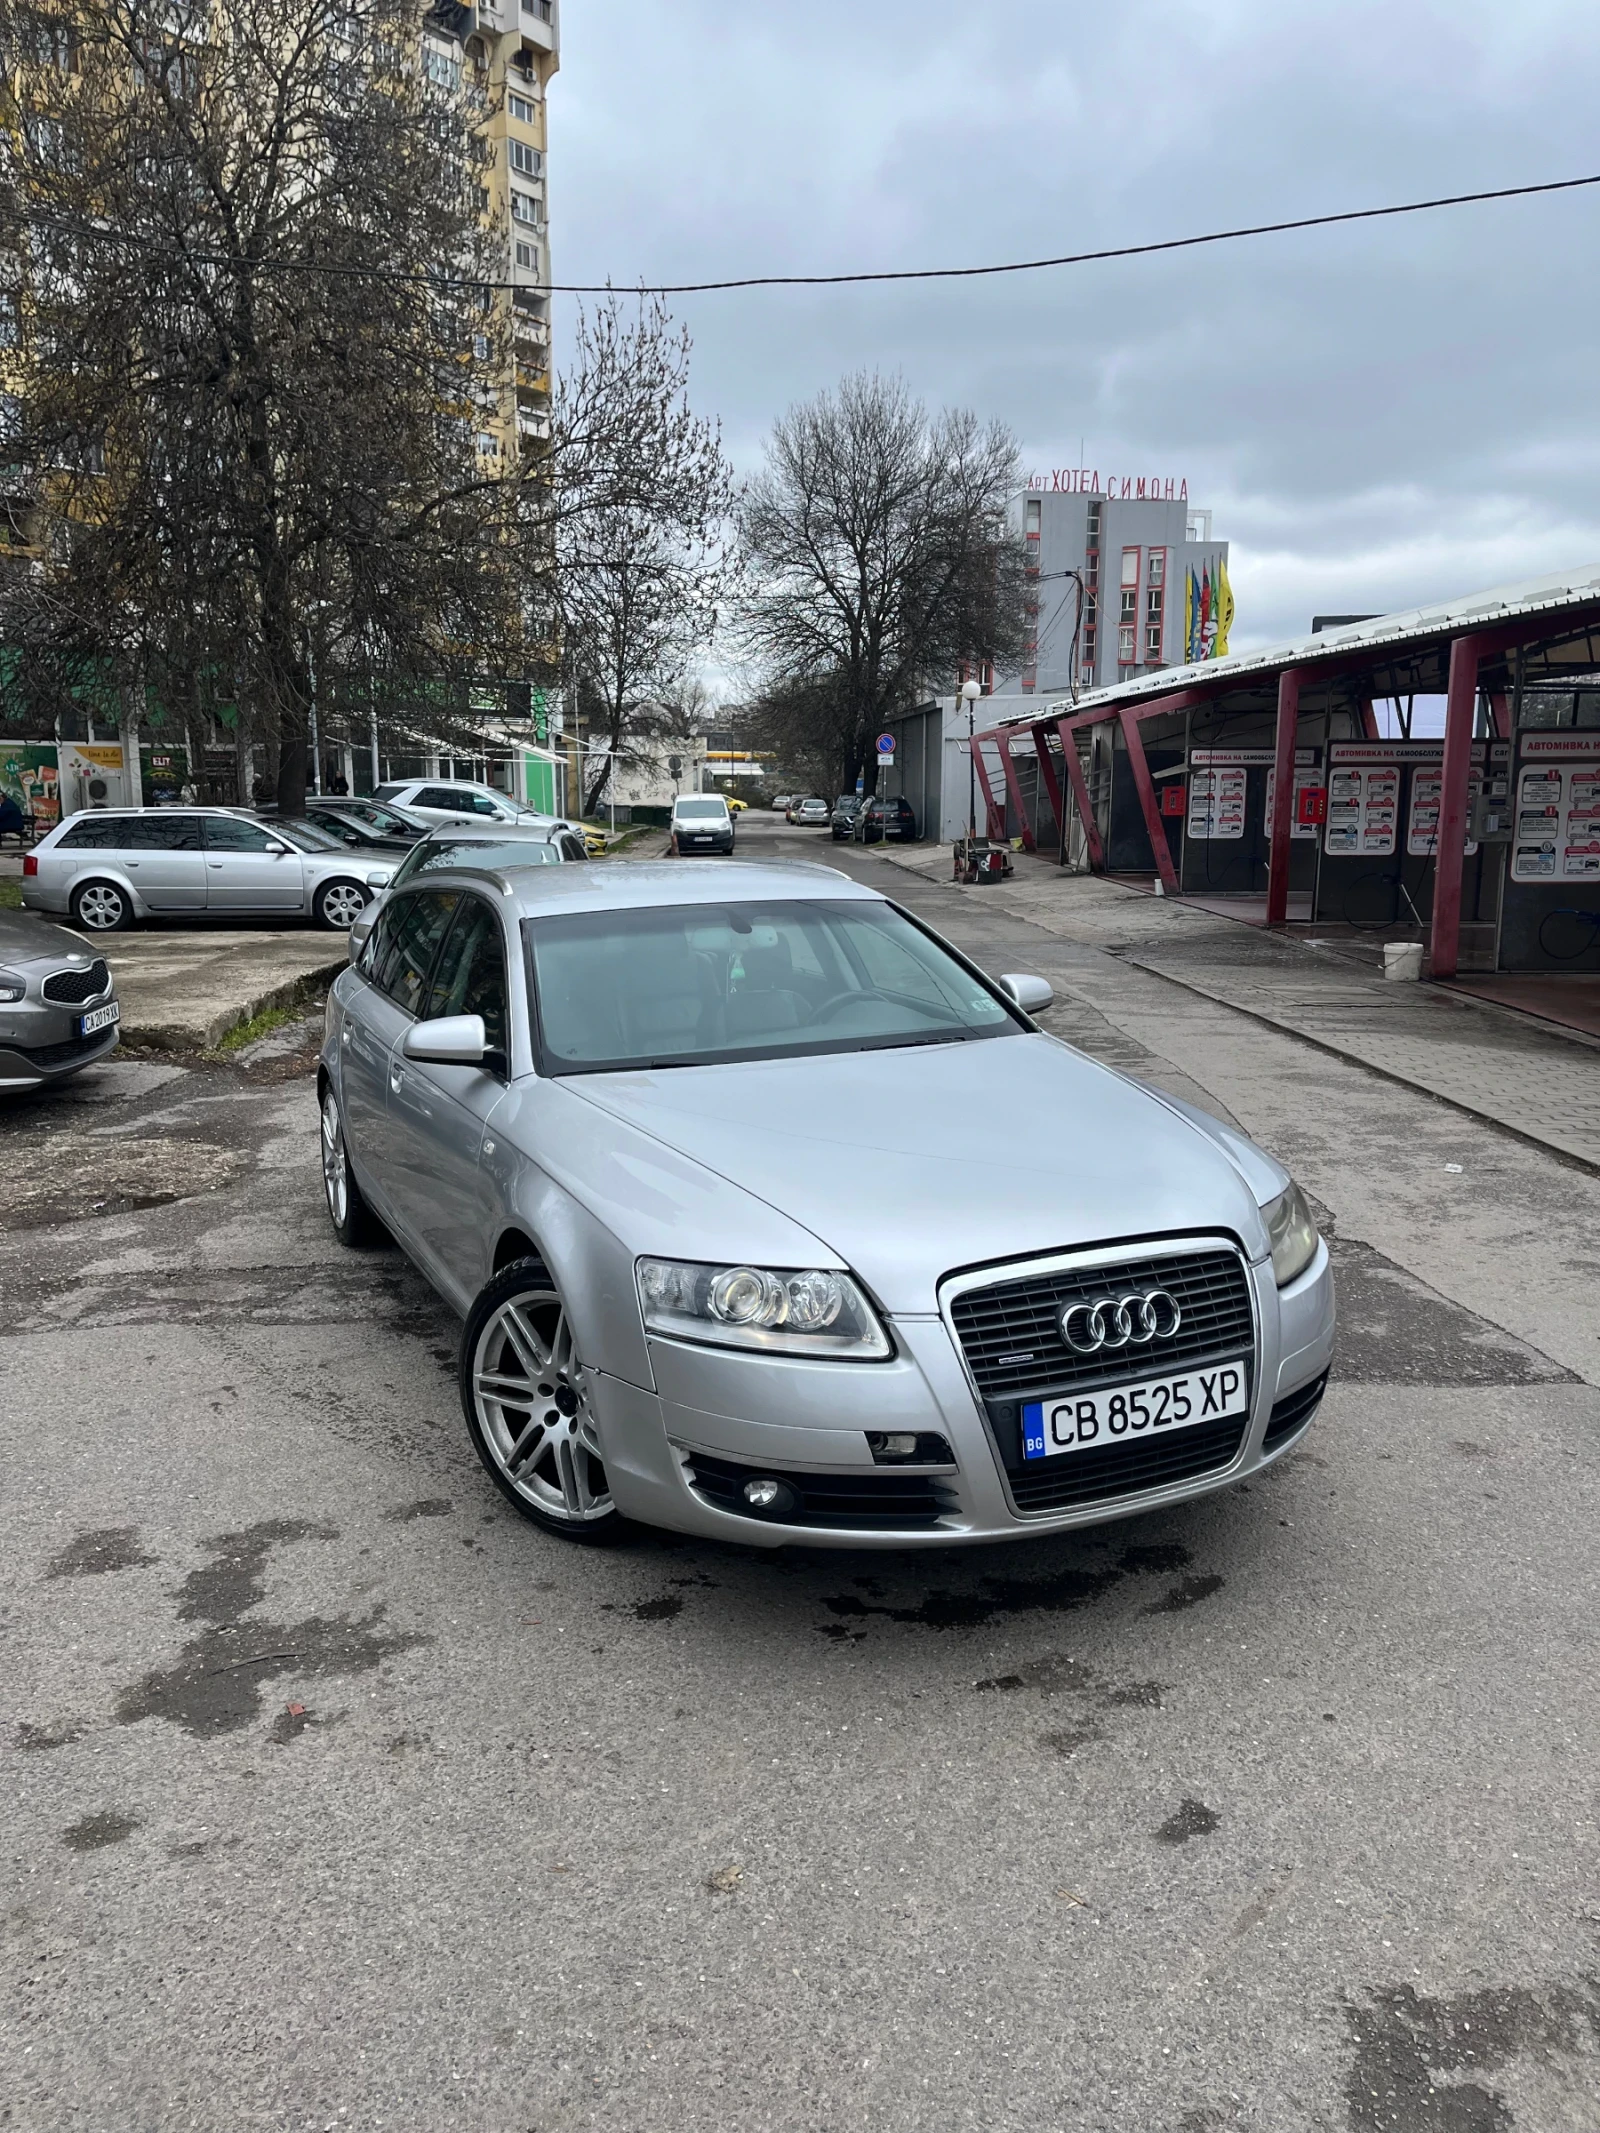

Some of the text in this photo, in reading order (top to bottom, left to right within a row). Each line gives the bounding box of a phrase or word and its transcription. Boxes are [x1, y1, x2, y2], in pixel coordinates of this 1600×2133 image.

[1028, 469, 1188, 501] АРТ ХОТЕЛ СИМОНА
[1335, 749, 1382, 757] АВТОМИВКА
[1383, 749, 1394, 757] НА
[1526, 742, 1591, 750] АВТОМИВКА
[95, 1008, 110, 1027] 2019
[1051, 1369, 1239, 1446] CB 8525 XP
[1026, 1438, 1044, 1453] BG
